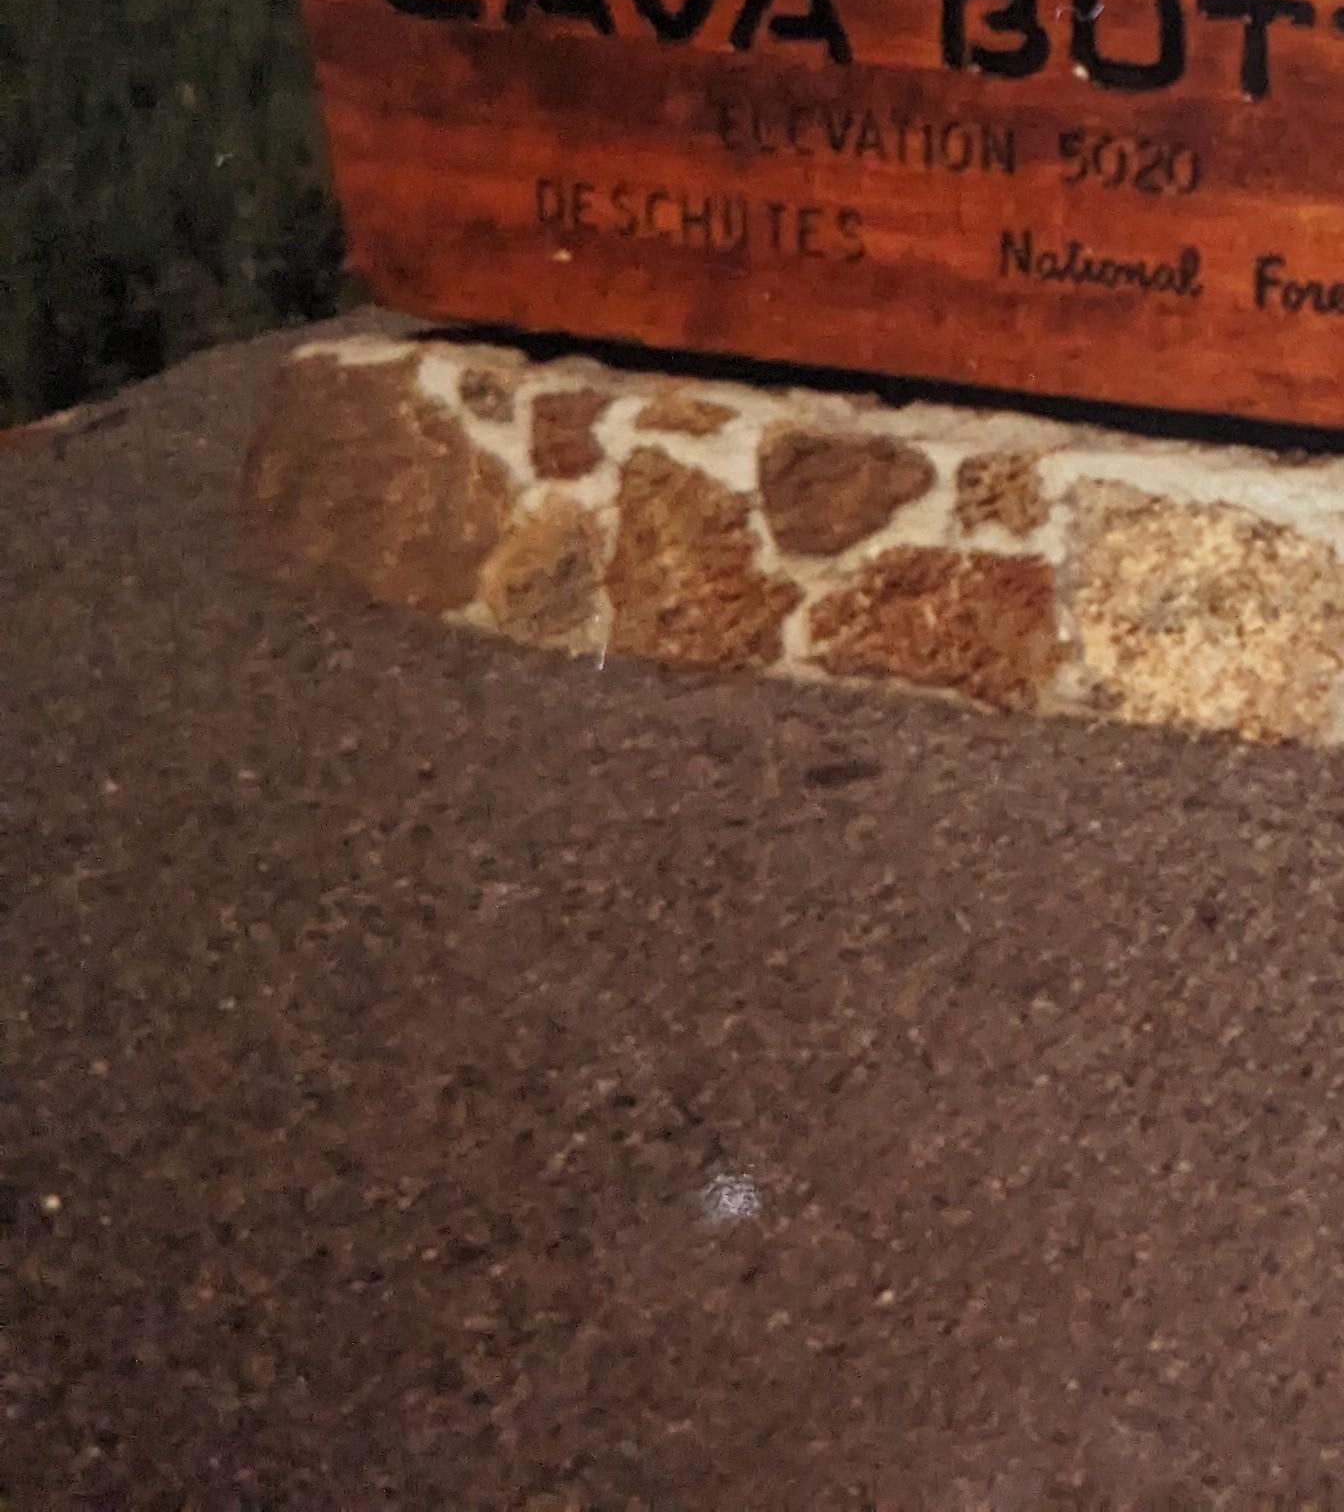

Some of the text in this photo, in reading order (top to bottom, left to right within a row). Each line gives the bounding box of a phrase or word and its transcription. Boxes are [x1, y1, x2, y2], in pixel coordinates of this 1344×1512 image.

[717, 100, 1200, 196] ELEVATION 5020
[535, 177, 867, 264] DESCHUTES
[1000, 231, 1203, 299] National
